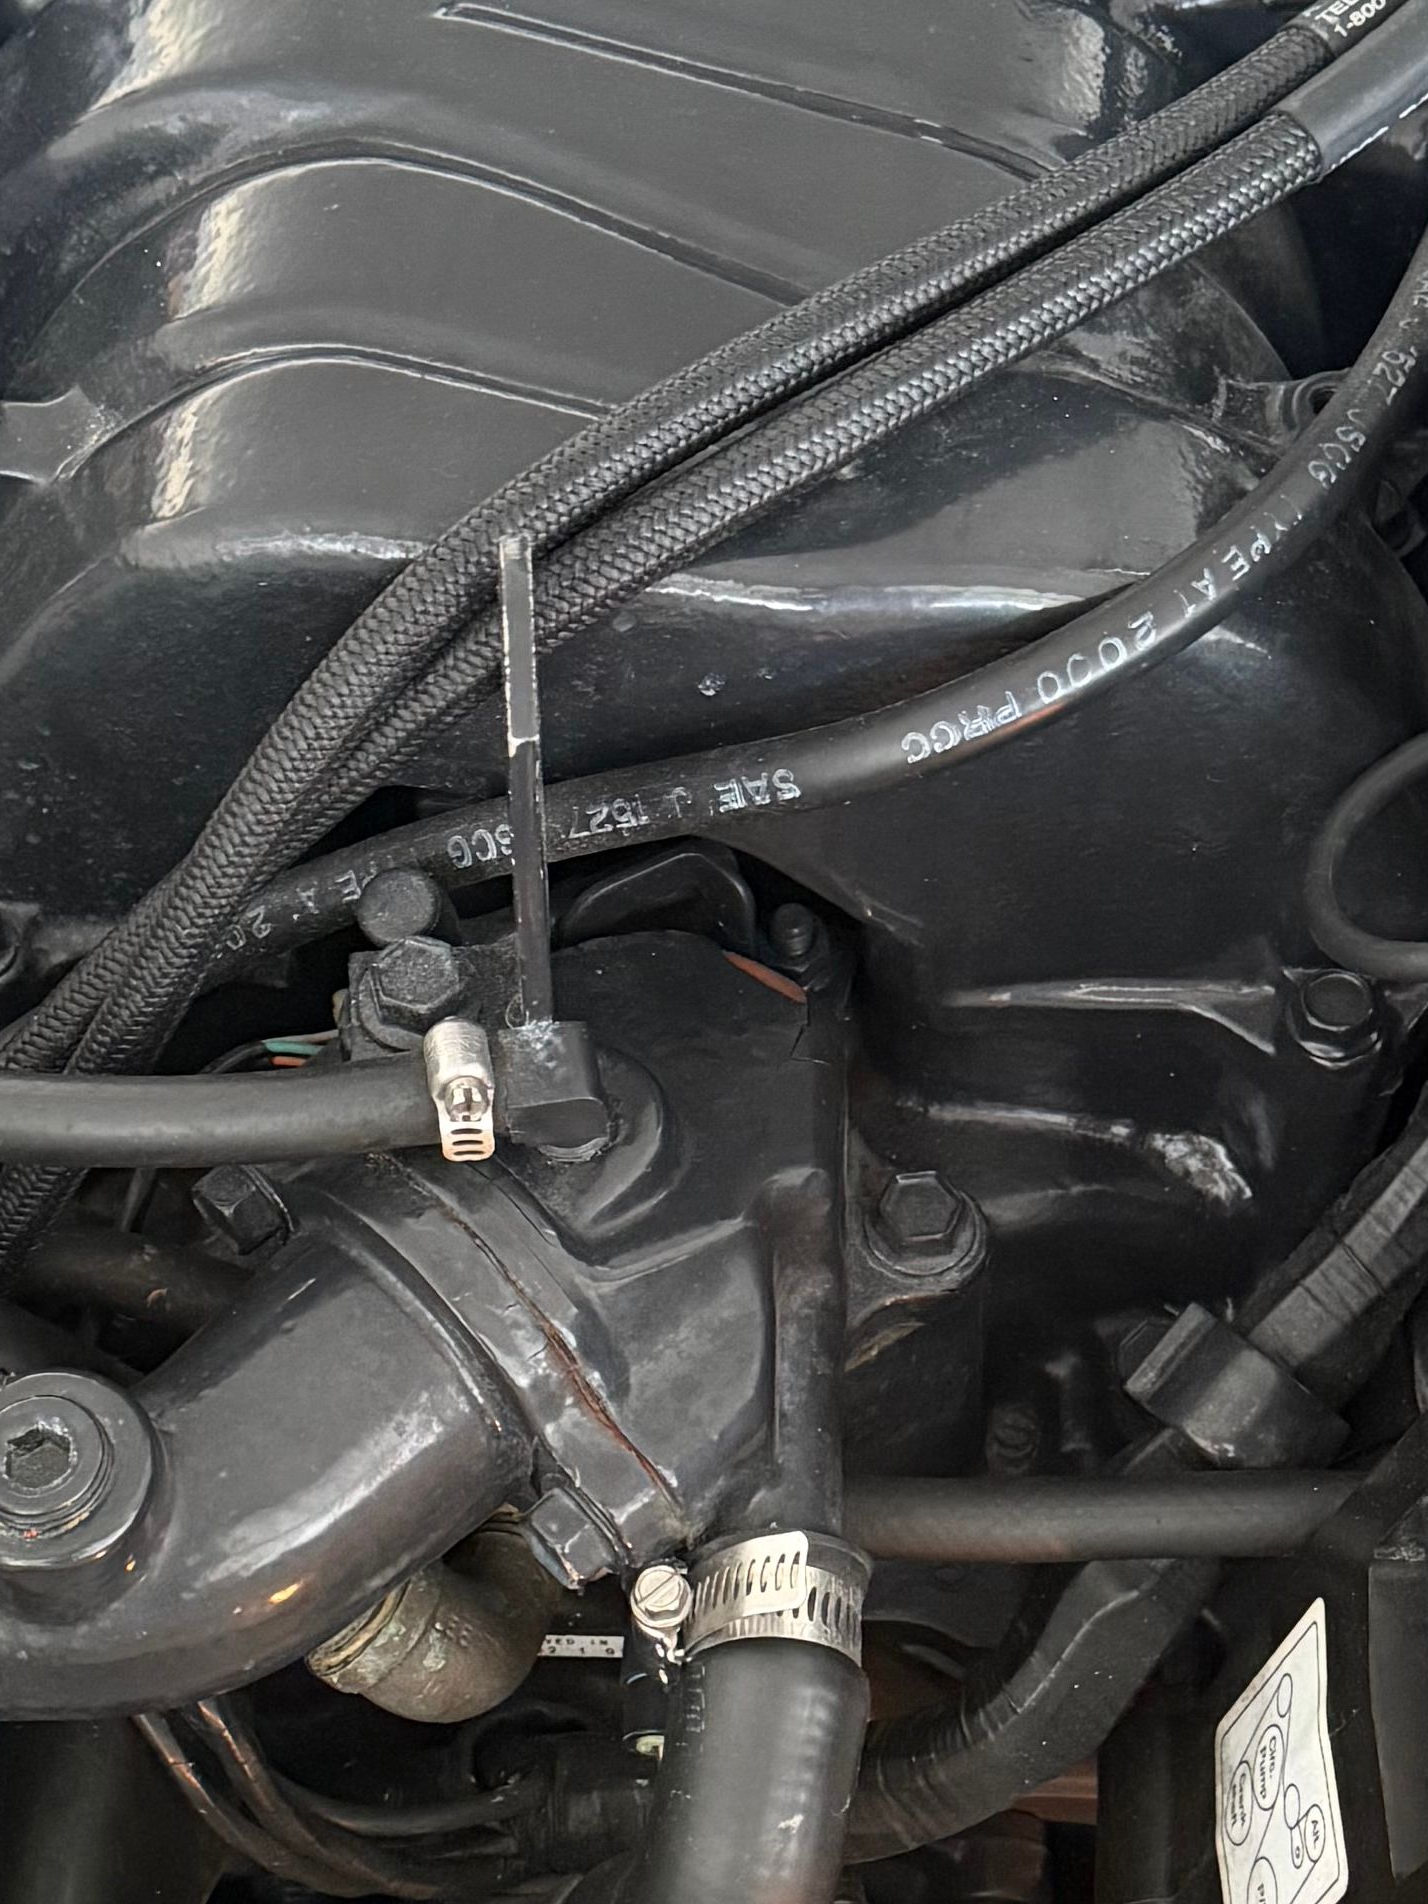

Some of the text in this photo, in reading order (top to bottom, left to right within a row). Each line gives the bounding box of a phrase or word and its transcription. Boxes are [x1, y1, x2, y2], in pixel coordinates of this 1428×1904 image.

[1037, 611, 1158, 705] 2000
[713, 768, 802, 813] SAE
[447, 823, 514, 869] SCG
